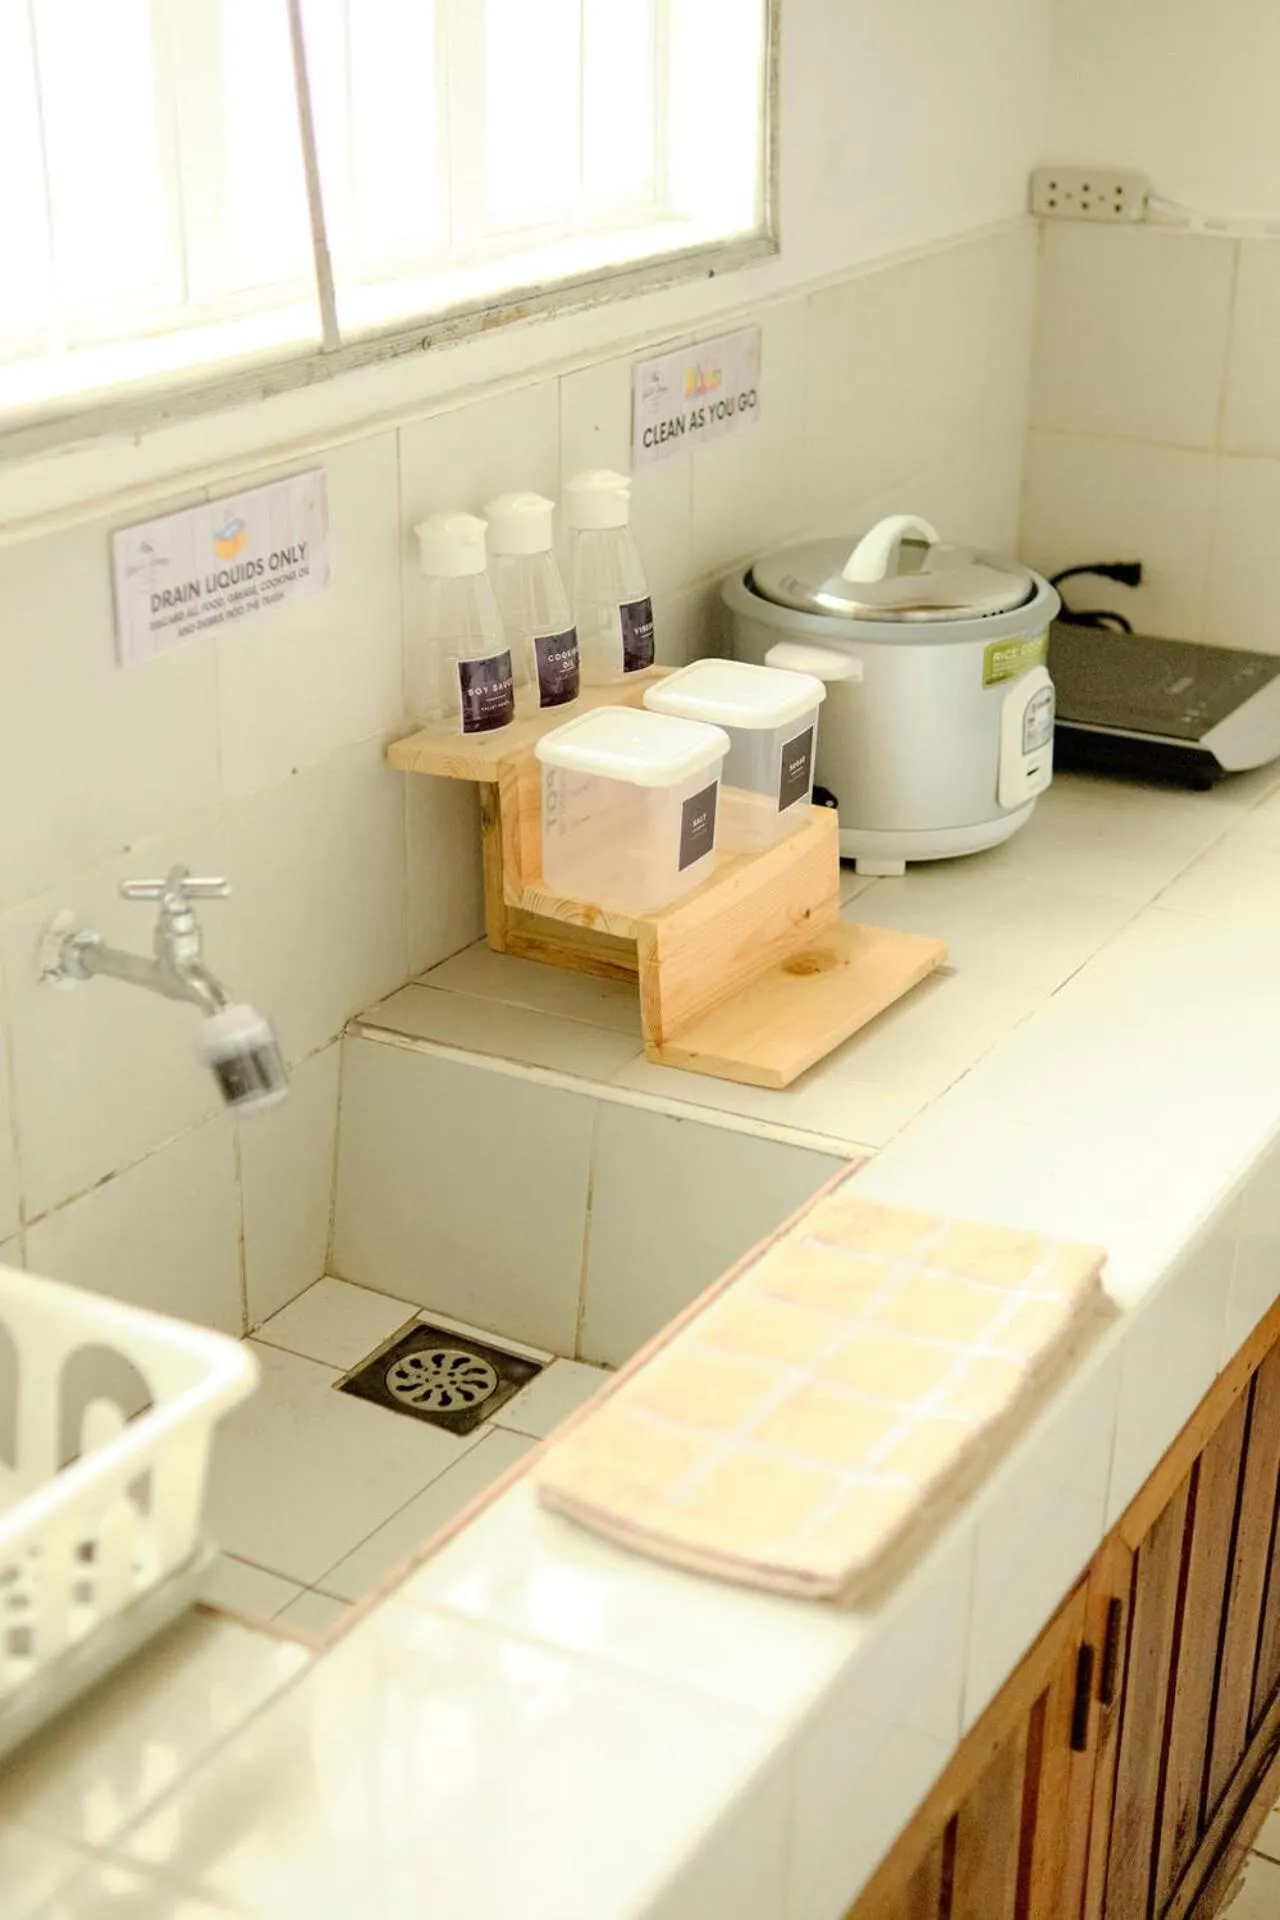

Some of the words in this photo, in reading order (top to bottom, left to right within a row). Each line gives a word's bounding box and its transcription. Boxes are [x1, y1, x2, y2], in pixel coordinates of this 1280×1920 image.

[643, 414, 685, 448] CLEAN
[689, 408, 705, 432] AS
[708, 396, 735, 424] YOU
[738, 389, 757, 412] GO
[150, 579, 201, 613] DRAIN
[205, 558, 265, 594] LIQUIDS
[268, 542, 308, 570] ONLY
[468, 686, 488, 697] SOY
